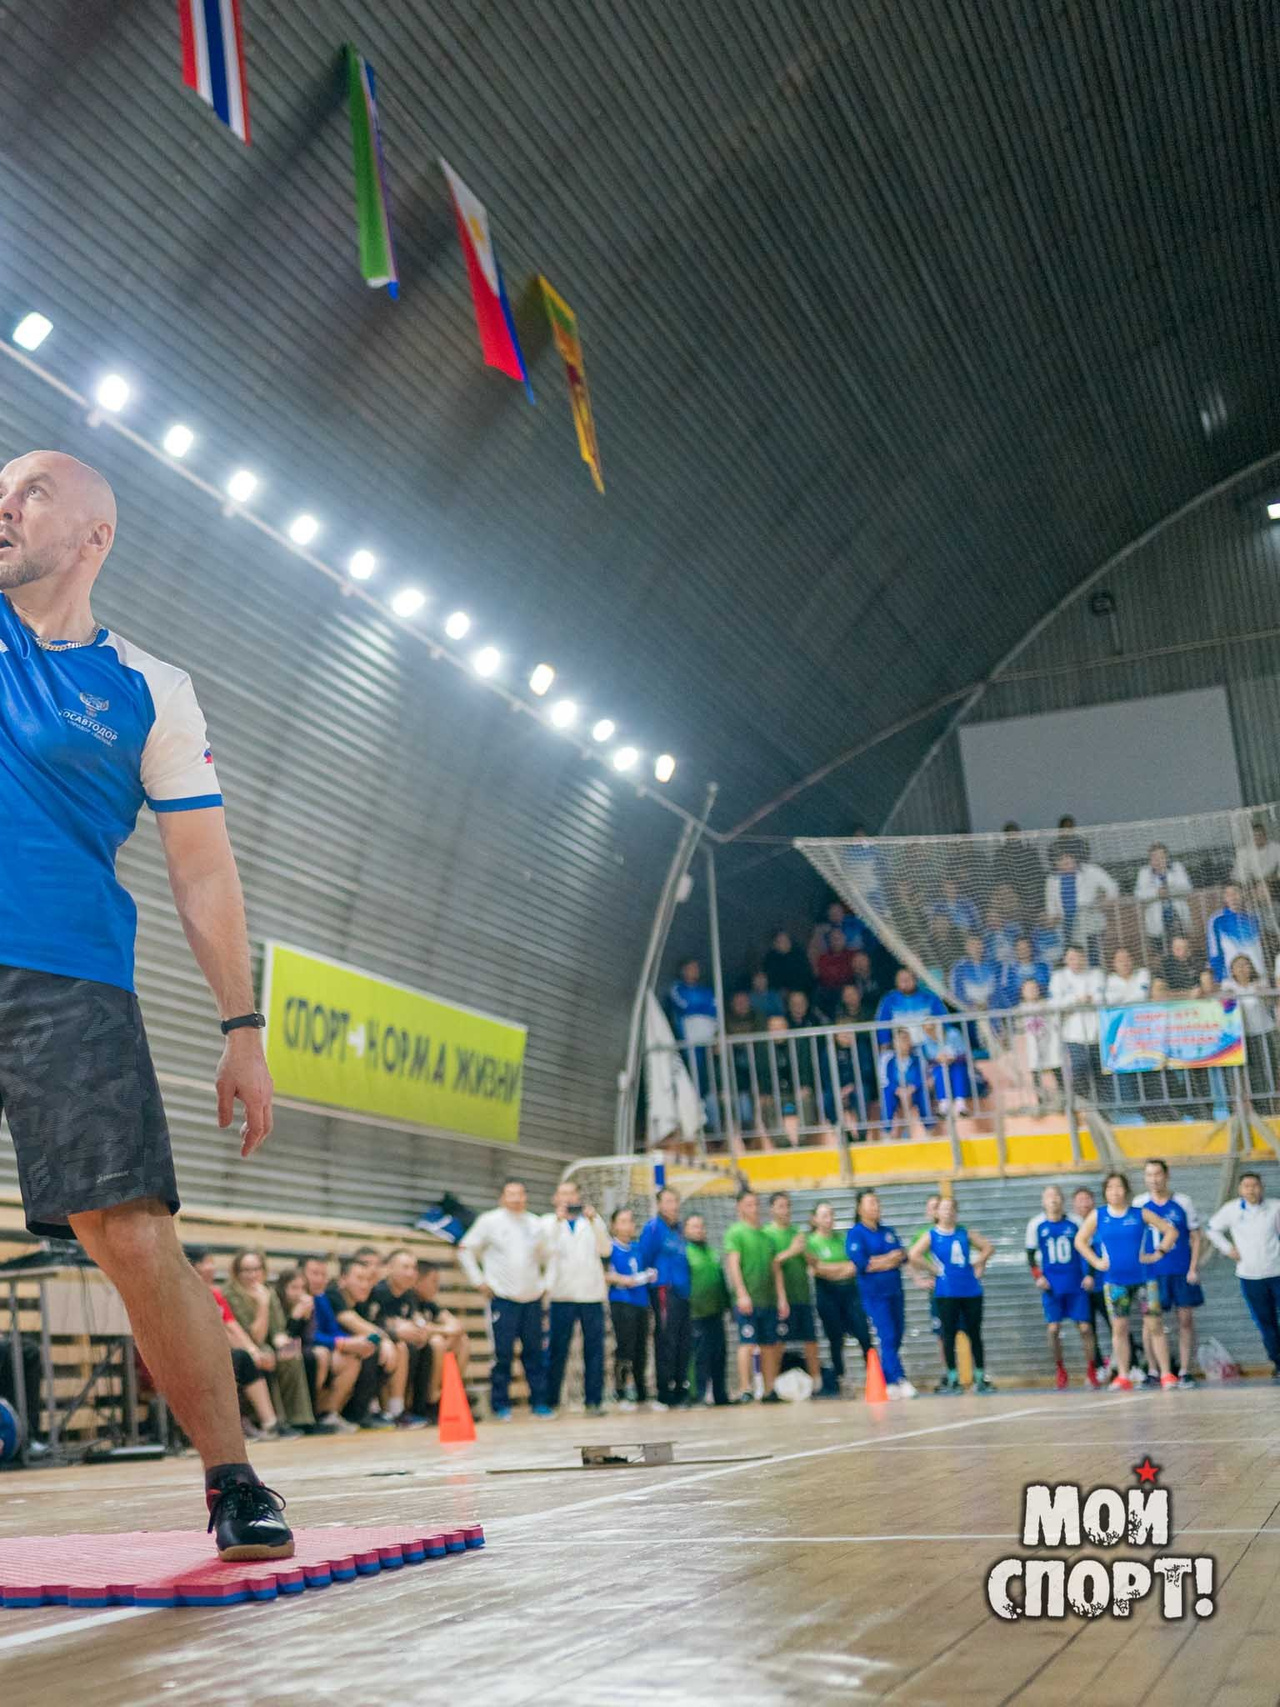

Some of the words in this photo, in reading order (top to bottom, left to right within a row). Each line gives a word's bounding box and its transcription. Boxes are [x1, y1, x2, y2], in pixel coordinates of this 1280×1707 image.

[58, 709, 118, 741] ОСАВТОДОР
[283, 996, 350, 1063] СПОРТ
[366, 1015, 448, 1088] НОРМА
[452, 1045, 520, 1104] ЖИЗНИ
[1046, 1235, 1072, 1264] 10
